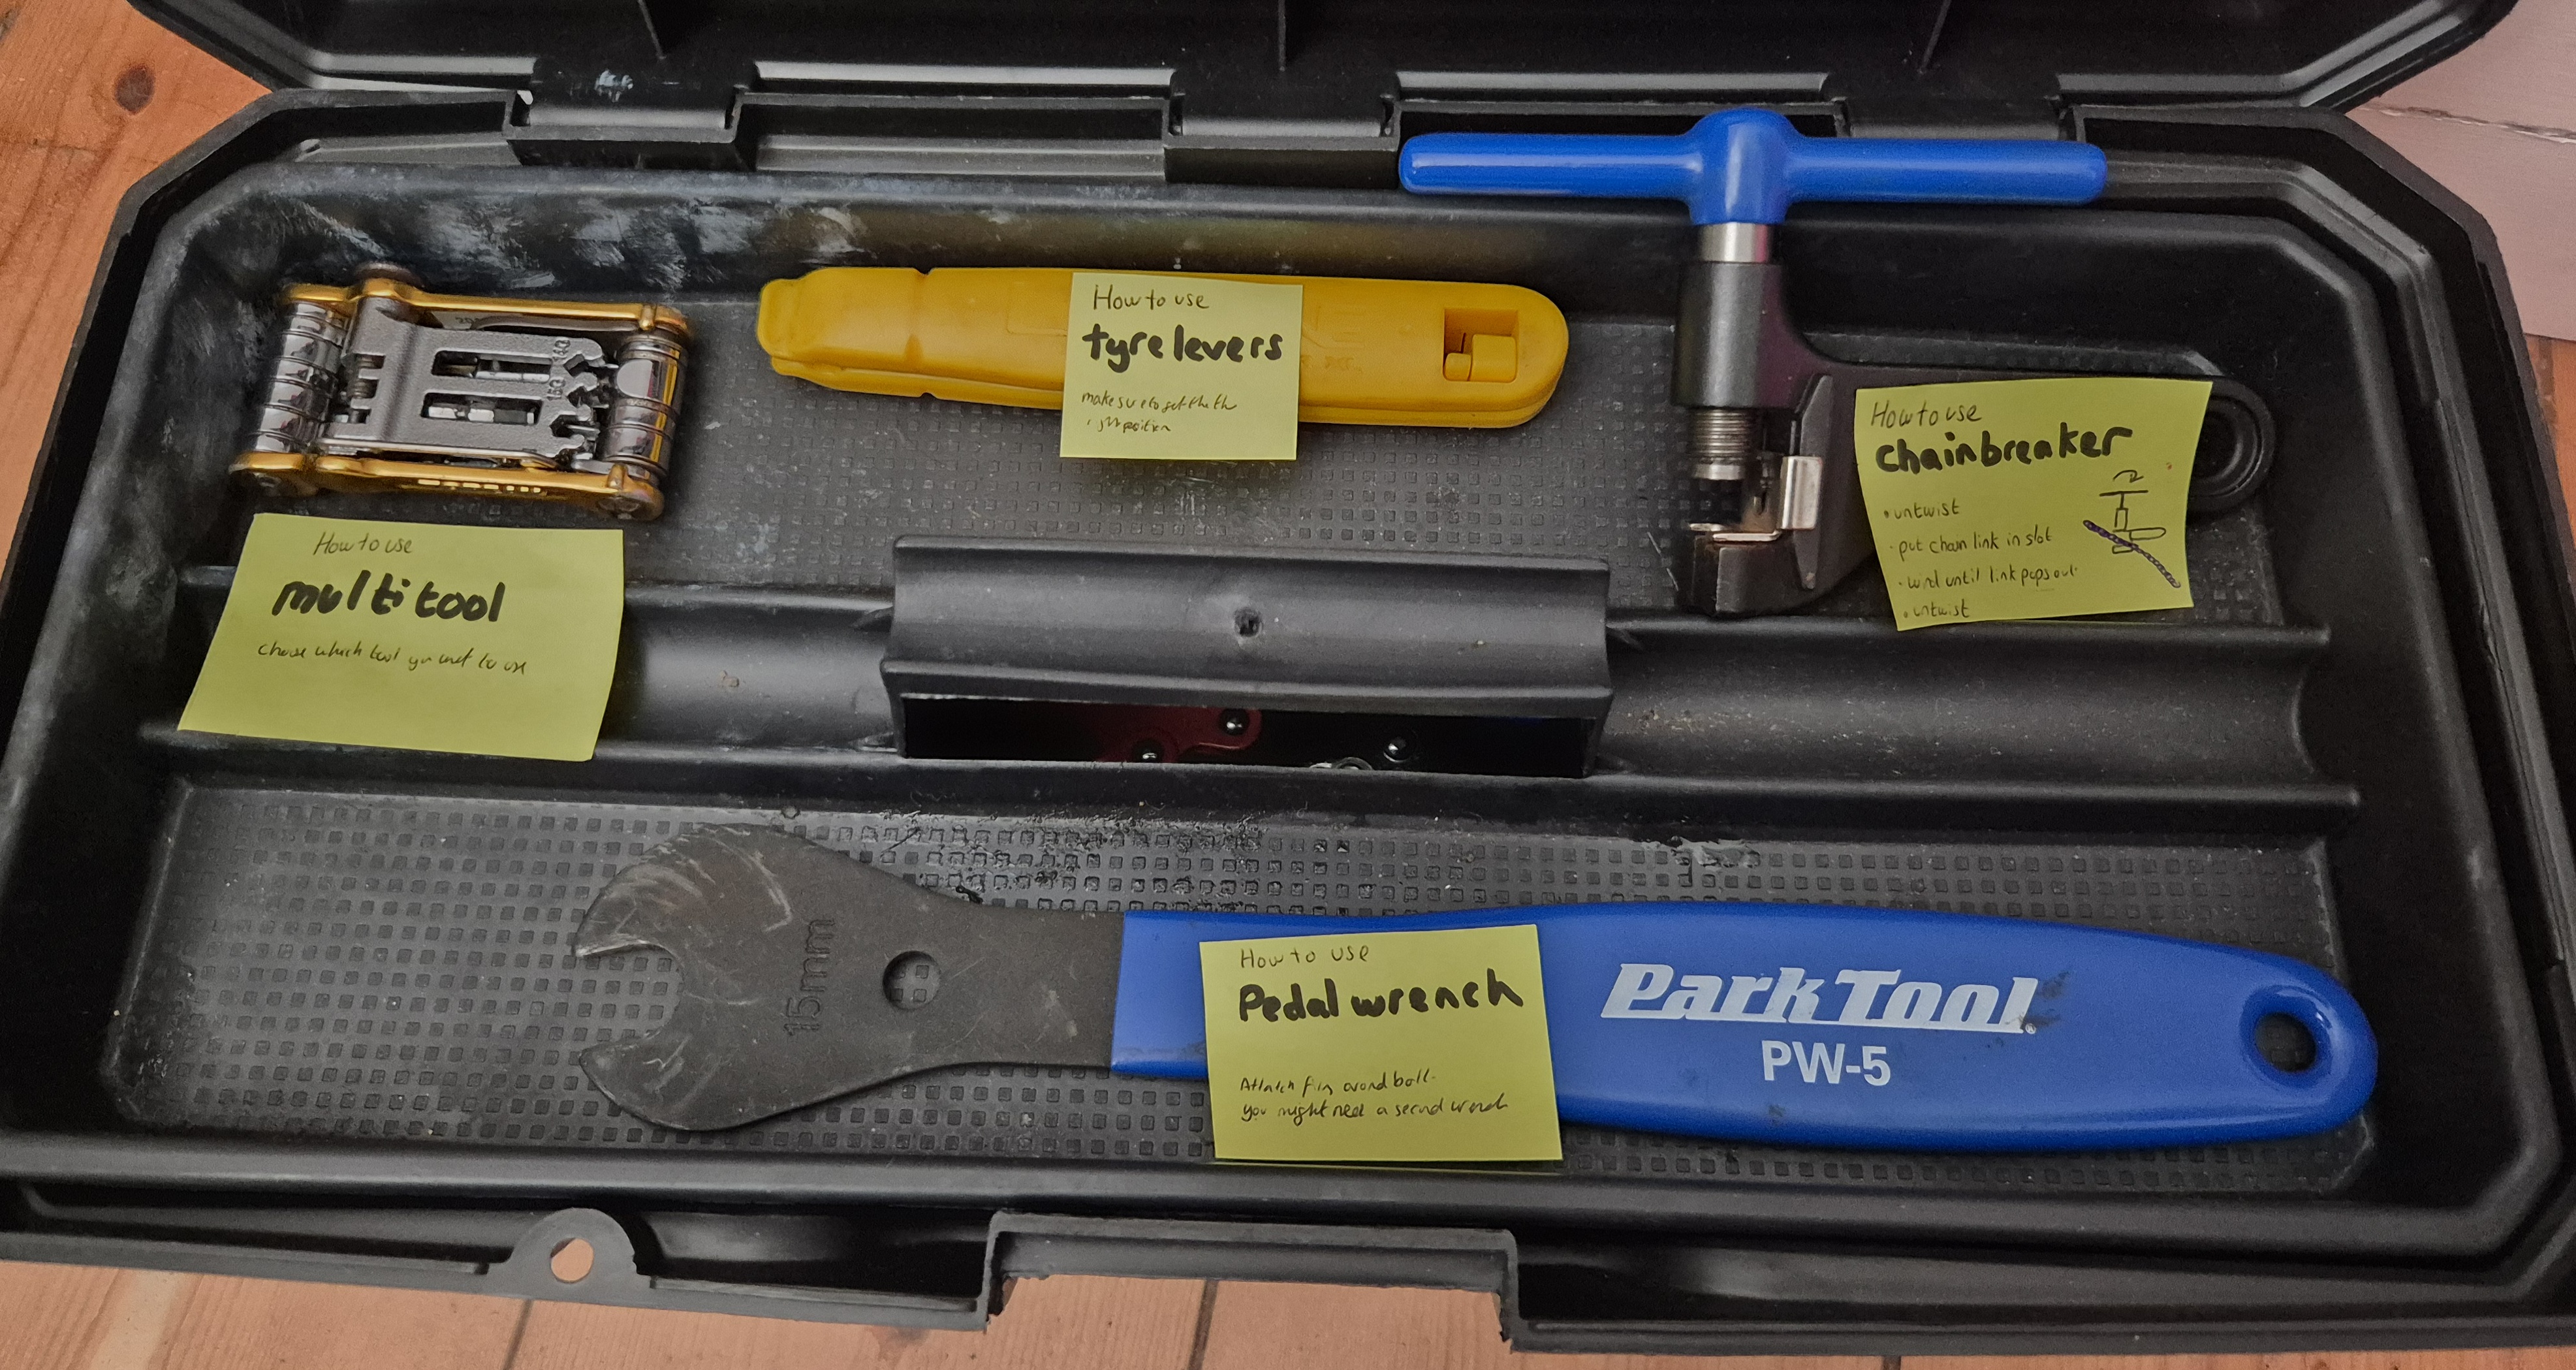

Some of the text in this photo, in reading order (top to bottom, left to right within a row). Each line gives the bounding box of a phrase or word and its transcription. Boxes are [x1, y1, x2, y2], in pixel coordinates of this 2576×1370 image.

[1093, 285, 1210, 311] How to use
[1081, 323, 1164, 374] tyre
[1172, 324, 1283, 364] levers
[1870, 399, 1983, 429] How to use
[1876, 422, 2133, 475] chainbreaker
[1894, 497, 1960, 520] untwist
[312, 532, 412, 556] How to use
[1898, 523, 2052, 562] put chain link in slot
[1945, 567, 1980, 587] until
[1989, 563, 2017, 584] link
[2020, 567, 2050, 587] pops
[1913, 597, 1970, 619] untwist
[314, 640, 363, 658] which
[369, 644, 401, 663] tool
[1240, 944, 1370, 969] How to use
[783, 919, 836, 1036] 15mm
[1238, 967, 1524, 1023] Pedal wrench
[1761, 1040, 1891, 1086] PW-5
[1240, 1104, 1267, 1123] you
[1278, 1096, 1328, 1127] might
[1376, 1106, 1389, 1115] a
